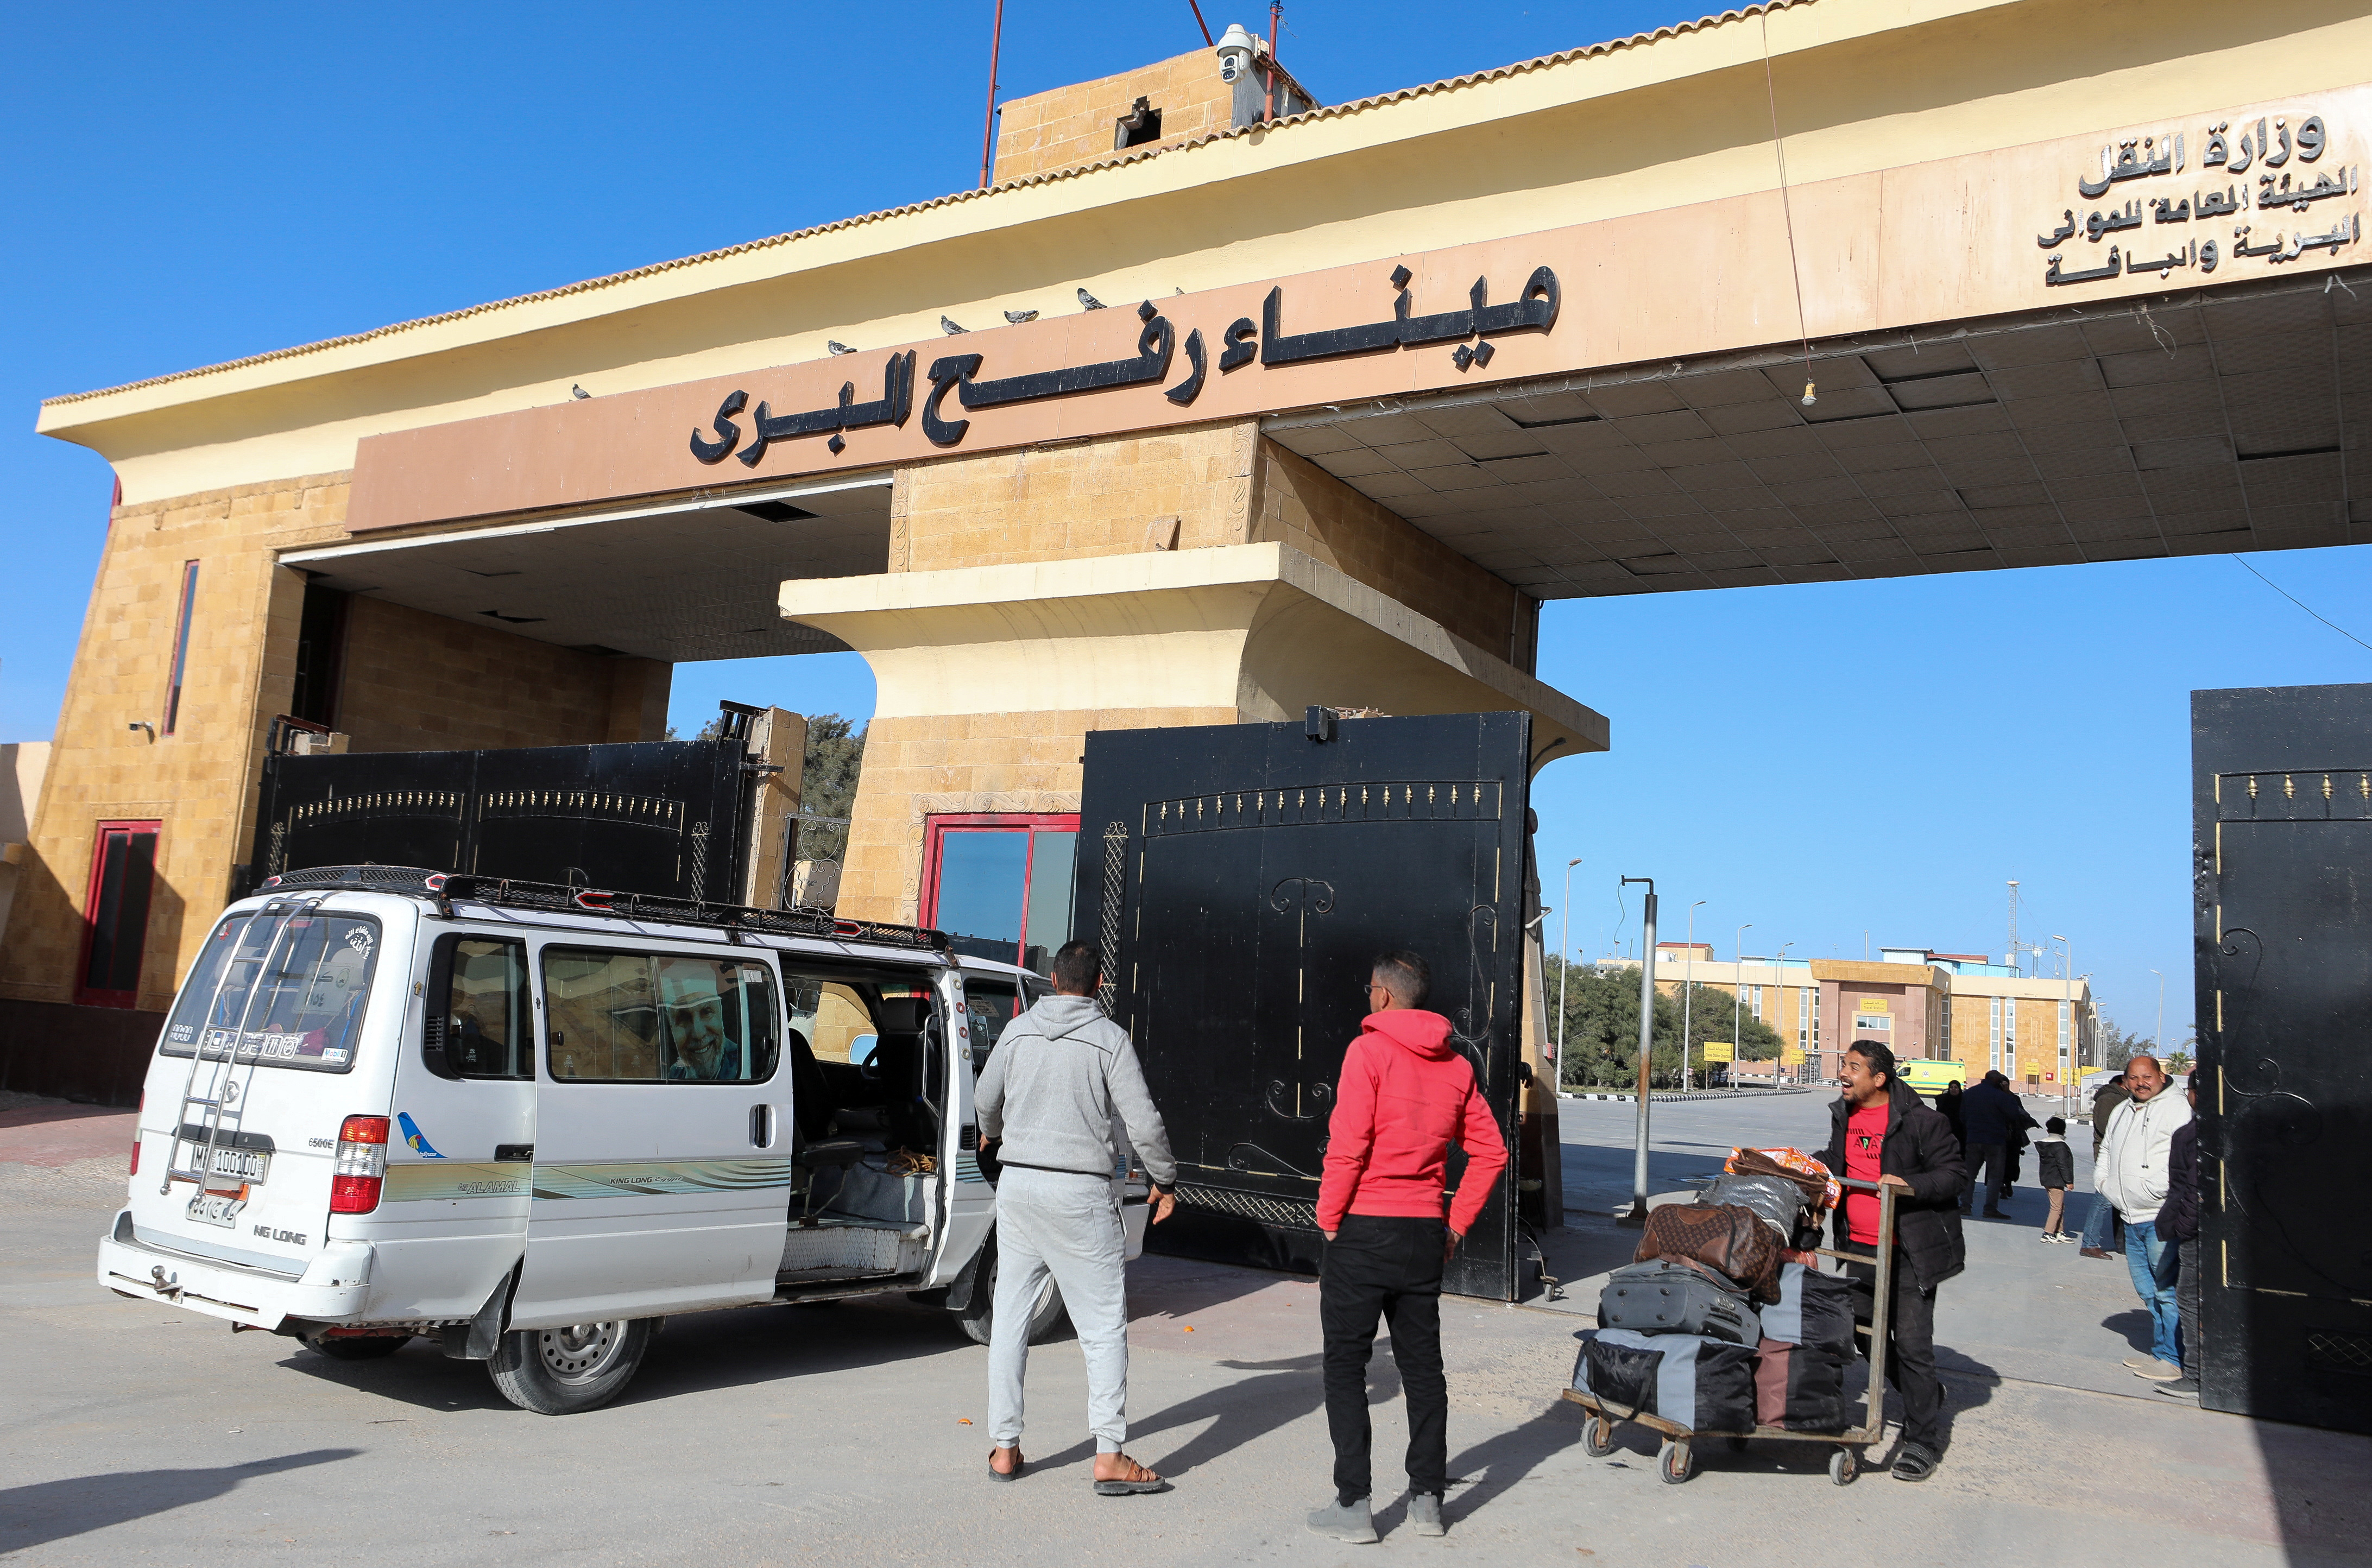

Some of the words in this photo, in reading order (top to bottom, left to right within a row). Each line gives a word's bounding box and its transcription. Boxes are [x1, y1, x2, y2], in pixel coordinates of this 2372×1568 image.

[2078, 131, 2184, 199] النقل
[2203, 115, 2326, 174] وزارة
[2148, 183, 2249, 224] العامة
[2259, 163, 2357, 213] الهيئة
[2046, 237, 2219, 287] والجافة
[2233, 211, 2361, 264] البرية
[1218, 264, 1561, 373] ميناء
[922, 299, 1208, 447] رفح
[324, 1048, 340, 1057] Mobil
[308, 1137, 335, 1149] 6500E
[458, 1183, 469, 1191] by
[466, 1180, 520, 1194] ALAMAL
[254, 1224, 272, 1238] NG
[273, 1229, 307, 1246] LONG
